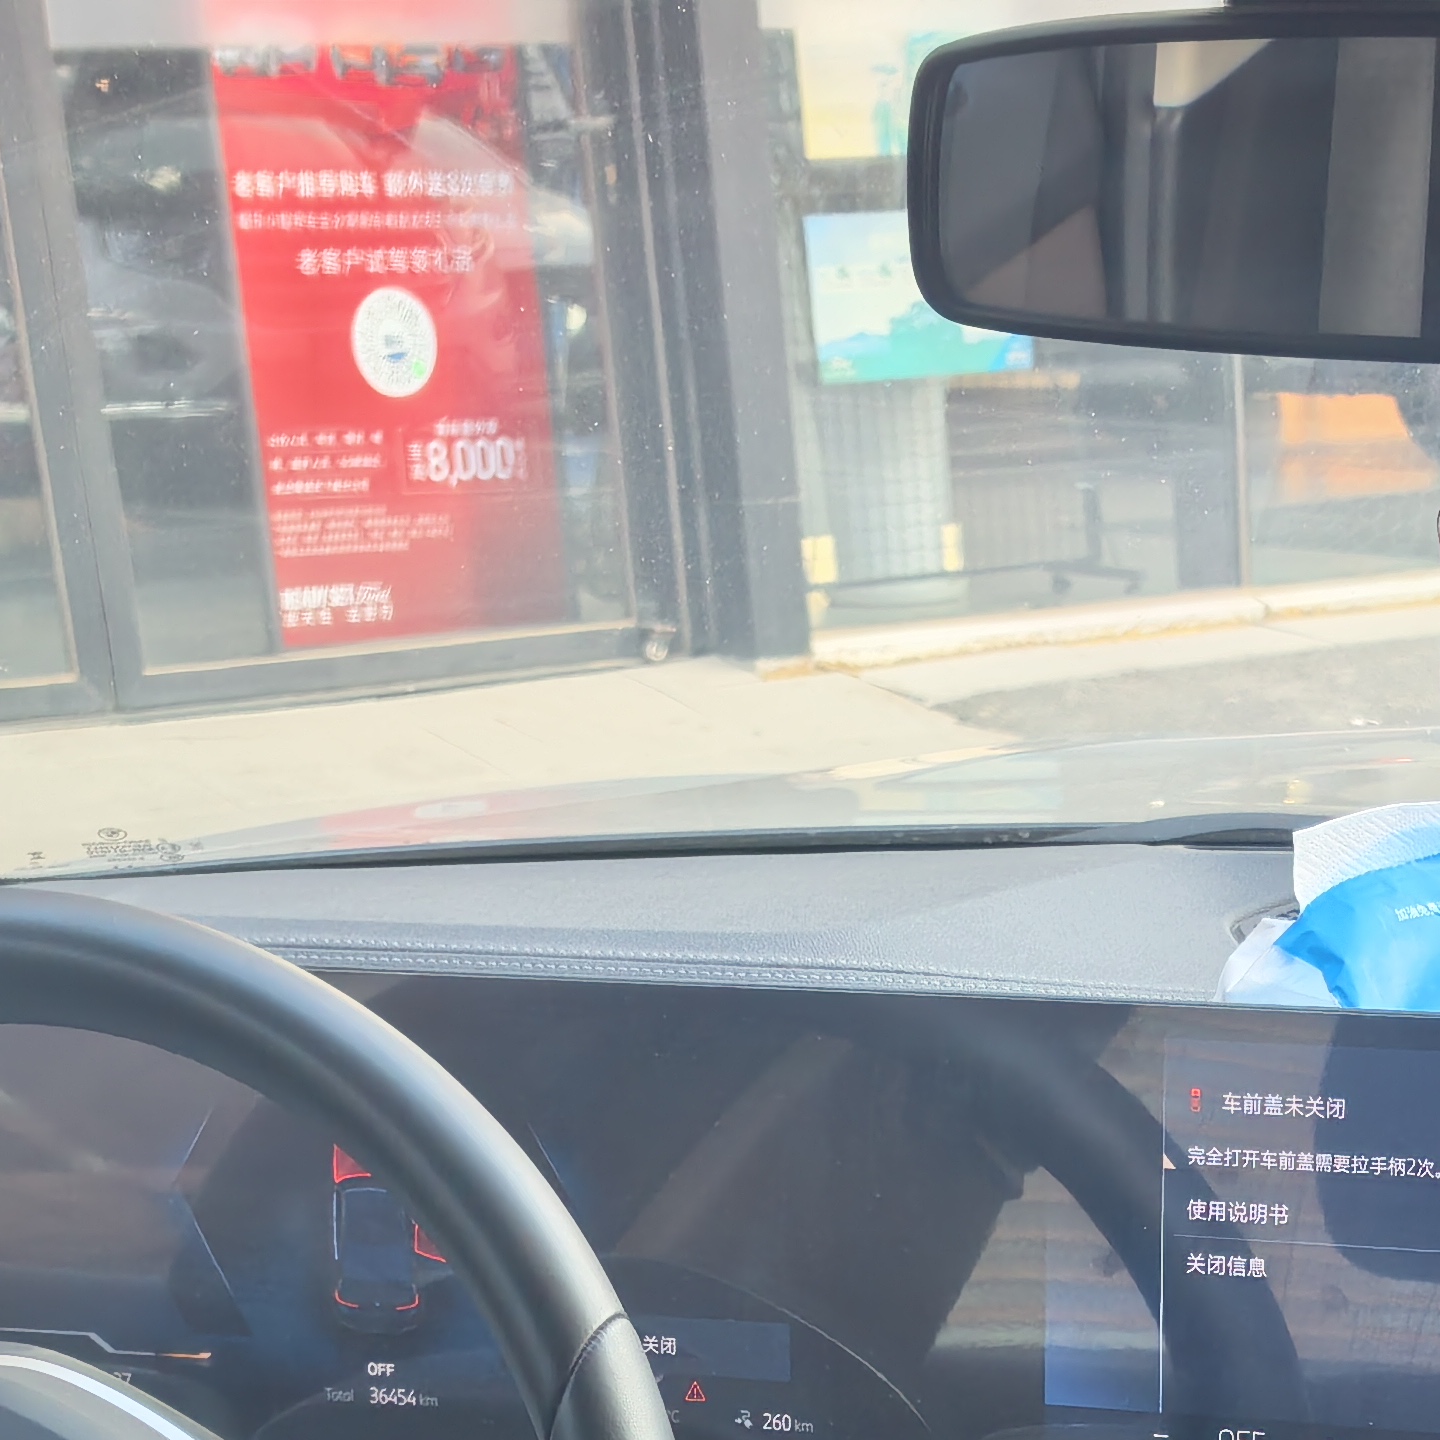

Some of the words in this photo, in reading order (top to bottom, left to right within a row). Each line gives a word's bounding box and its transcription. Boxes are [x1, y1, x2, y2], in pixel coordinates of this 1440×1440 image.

[426, 437, 516, 488] 8,000
[1222, 1093, 1346, 1120] 车前盖未关闭
[1186, 1201, 1290, 1226] 使用说明书
[1186, 1254, 1268, 1279] 关闭信息
[642, 1335, 677, 1356] 关闭
[367, 1362, 395, 1377] OFF
[324, 1387, 355, 1403] Total
[369, 1386, 417, 1406] 36454
[418, 1392, 439, 1408] km
[762, 1412, 792, 1432] 260
[793, 1418, 814, 1434] km
